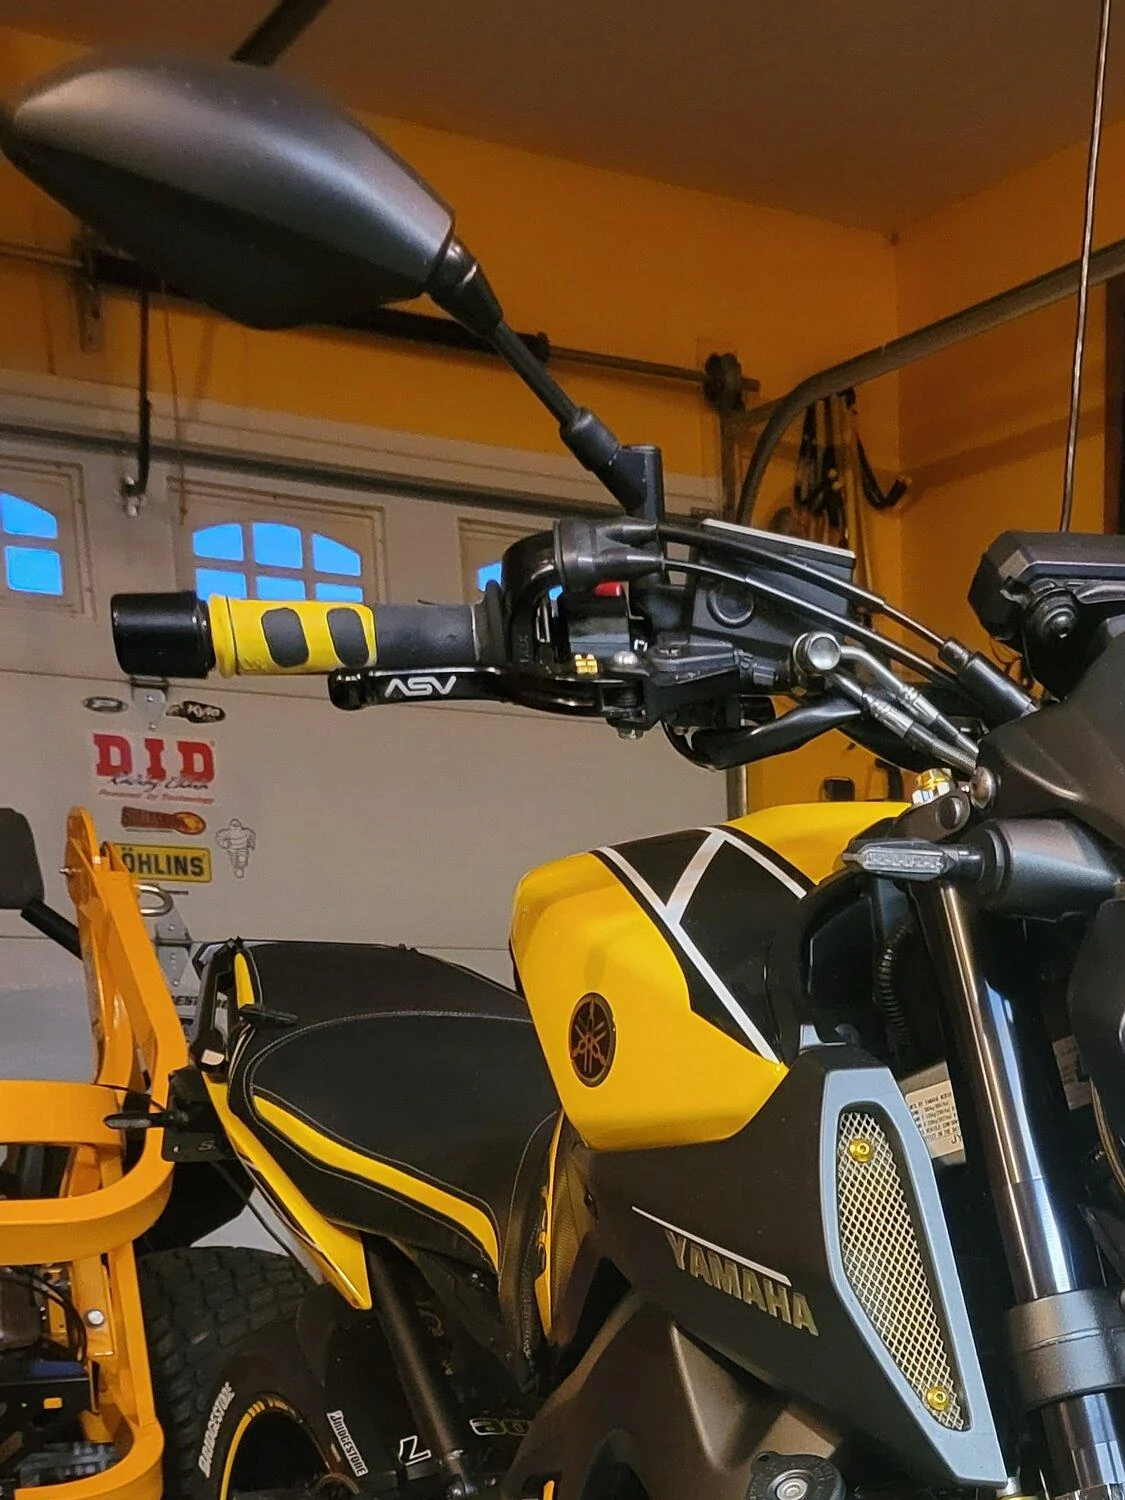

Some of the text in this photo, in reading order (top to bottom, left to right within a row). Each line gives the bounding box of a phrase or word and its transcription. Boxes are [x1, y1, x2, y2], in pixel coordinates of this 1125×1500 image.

[385, 676, 457, 698] ASV
[664, 1230, 819, 1337] YAMAHA
[330, 1411, 367, 1476] BRIDGESTONE
